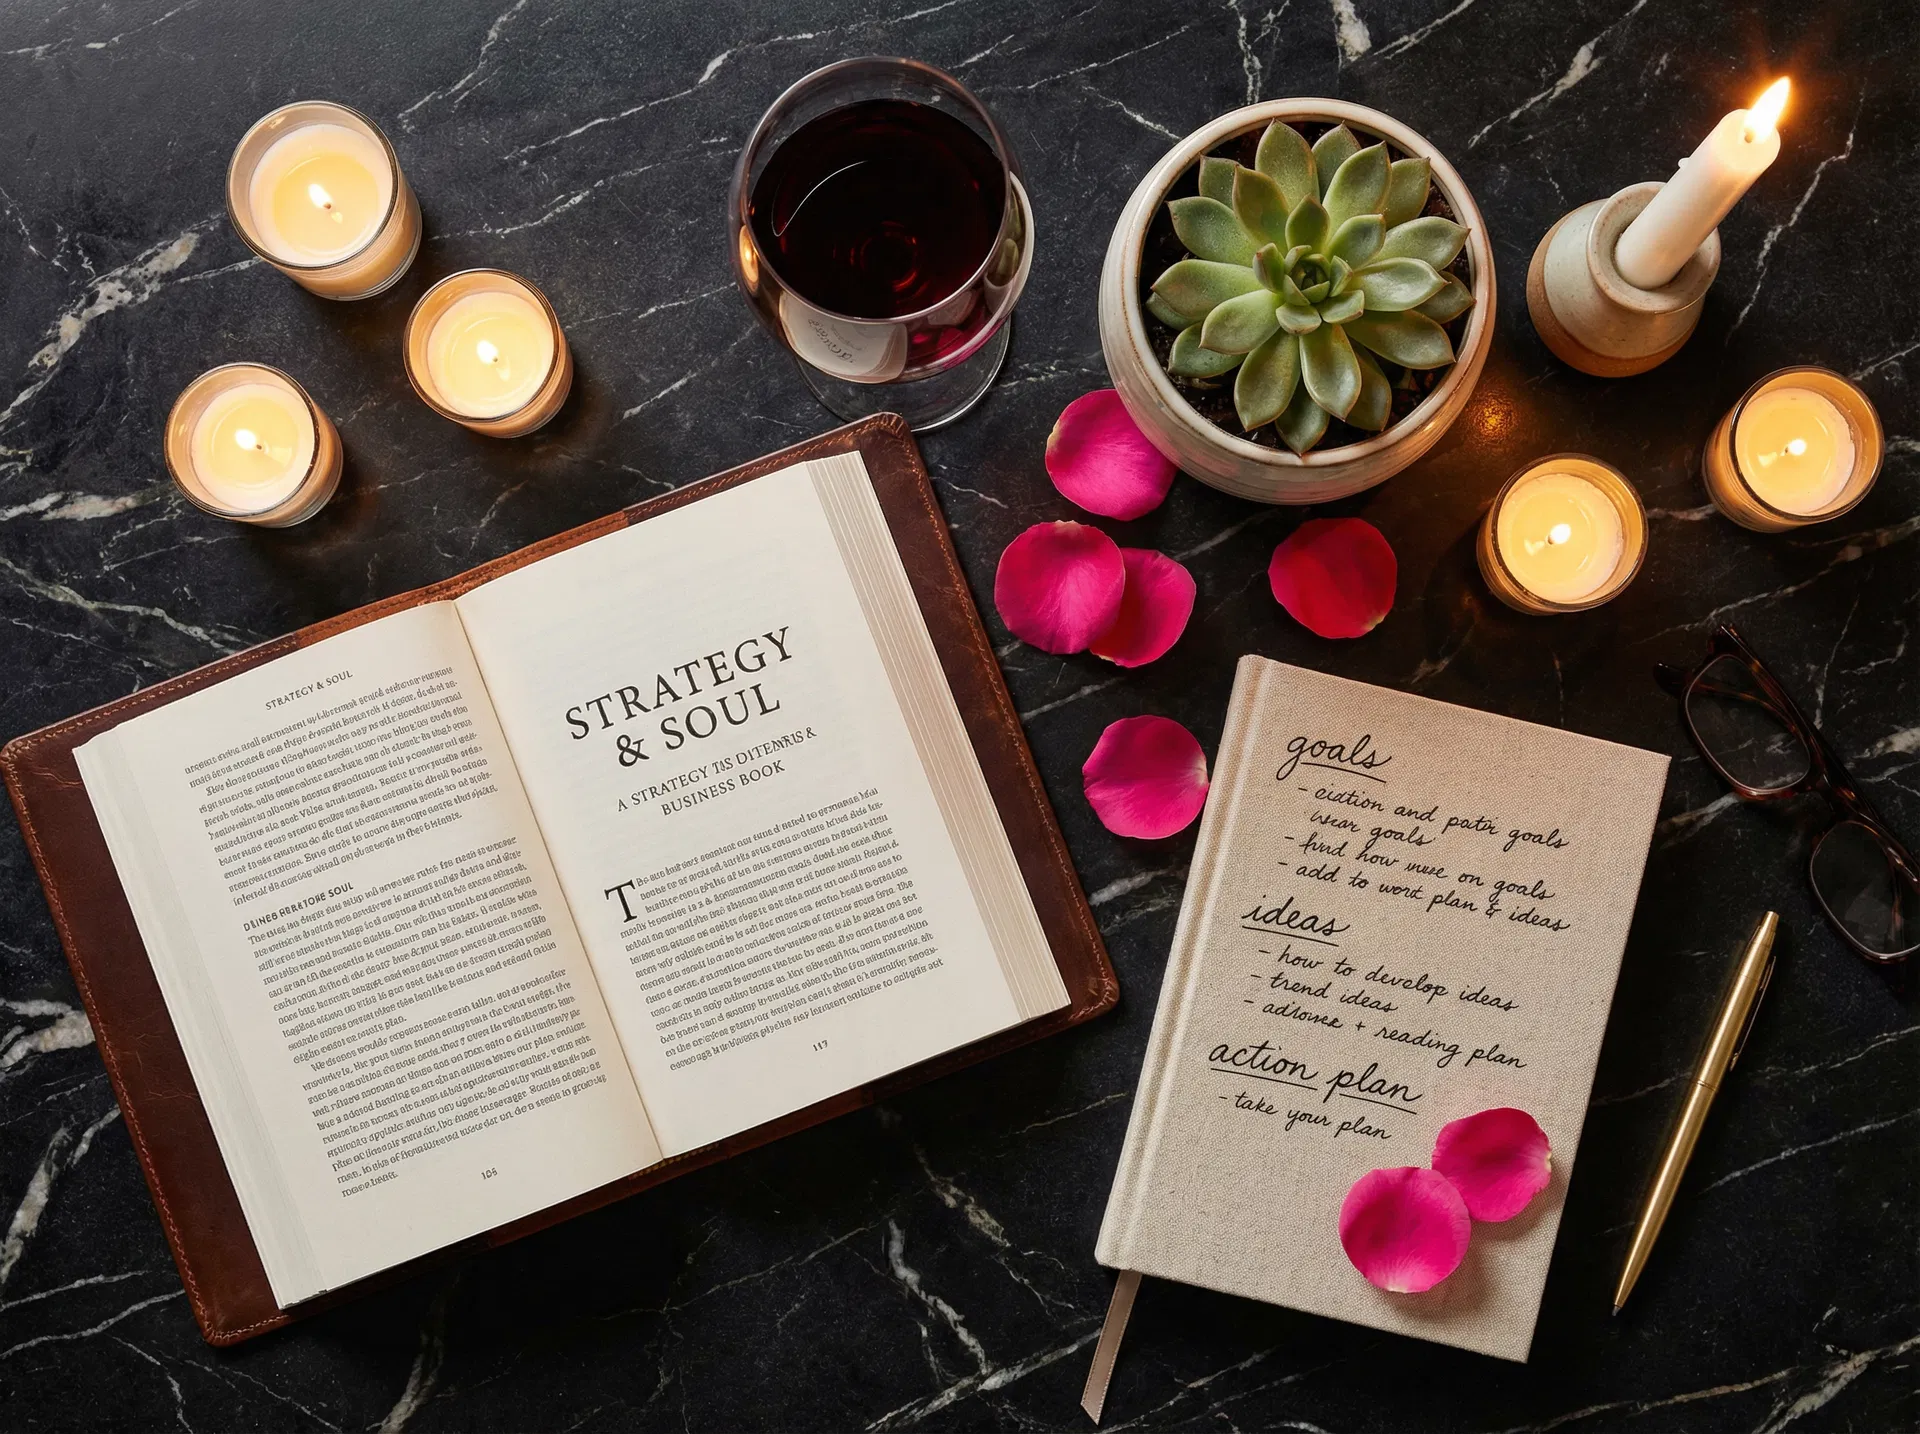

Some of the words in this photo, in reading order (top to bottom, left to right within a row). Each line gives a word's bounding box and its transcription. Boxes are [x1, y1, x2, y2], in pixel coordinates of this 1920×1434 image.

[266, 684, 313, 710] STRATEGY
[316, 681, 325, 690] &
[325, 670, 354, 687] SOUL
[566, 626, 792, 740] STRATEGY
[616, 735, 650, 767] &
[661, 683, 780, 750] SOUL
[618, 798, 629, 813] A
[631, 766, 708, 805] STRATEGY
[805, 726, 818, 739] &
[1276, 734, 1393, 781] goals
[661, 779, 735, 815] BUSINESS
[739, 760, 785, 786] BOOK
[1365, 826, 1432, 851] goals
[1393, 805, 1439, 823] and
[1503, 829, 1569, 852] goals
[327, 881, 354, 898] SOUL
[1295, 863, 1341, 883] add
[1347, 871, 1370, 890] to
[1426, 890, 1478, 912] plan
[1484, 902, 1502, 920] &
[1508, 906, 1570, 931] ideas
[1355, 845, 1399, 866] how
[1457, 872, 1485, 887] on
[1489, 880, 1556, 902] goals
[1242, 895, 1351, 937] ideas
[1271, 972, 1332, 998] trend
[1340, 989, 1398, 1012] ideas
[1278, 944, 1324, 968] how
[1333, 956, 1357, 977] to
[1365, 965, 1448, 1004] develop
[1459, 985, 1519, 1011] ideas
[1354, 1020, 1367, 1032] +
[1374, 1027, 1462, 1068] reading
[1465, 1044, 1527, 1068] plan
[1209, 1040, 1319, 1081] action
[1323, 1063, 1424, 1103] plan
[1235, 1091, 1278, 1115] take
[1285, 1110, 1332, 1131] your
[1334, 1116, 1392, 1139] plan
